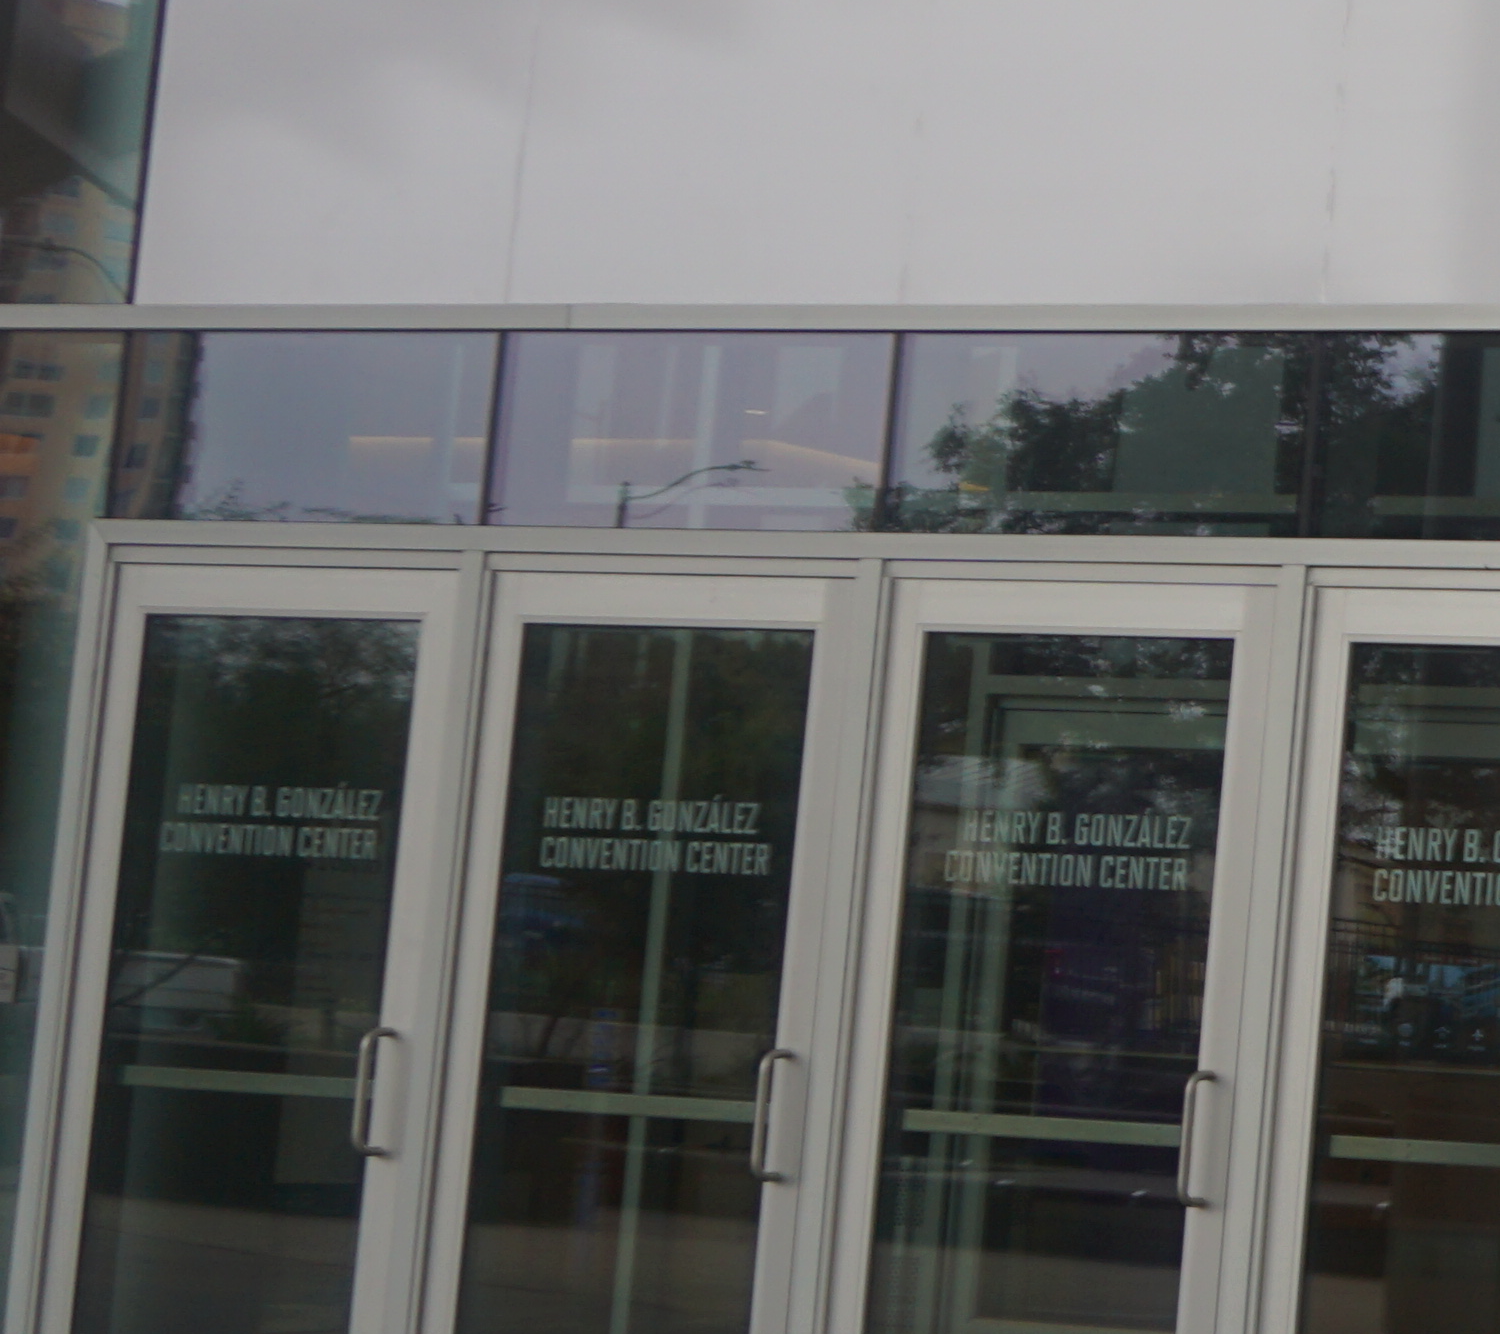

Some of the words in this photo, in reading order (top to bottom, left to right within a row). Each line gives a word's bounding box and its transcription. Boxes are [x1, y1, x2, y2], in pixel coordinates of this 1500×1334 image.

[176, 783, 249, 815] HENRY
[543, 796, 620, 829] HENRY
[620, 798, 642, 831] B.
[647, 794, 761, 834] GONZÁLEZ
[159, 821, 294, 857] CONVENTION
[296, 826, 378, 859] CENTER
[964, 811, 1042, 843] HENRY
[1046, 812, 1066, 845] B.
[1074, 807, 1192, 850] GONZÁLEZ
[1375, 826, 1458, 861] HENRY
[1462, 828, 1485, 863] B.
[540, 836, 682, 872] CONVENTION
[685, 841, 772, 875] CENTER
[944, 850, 1092, 888] CONVENTION
[1100, 855, 1188, 890] CENTER
